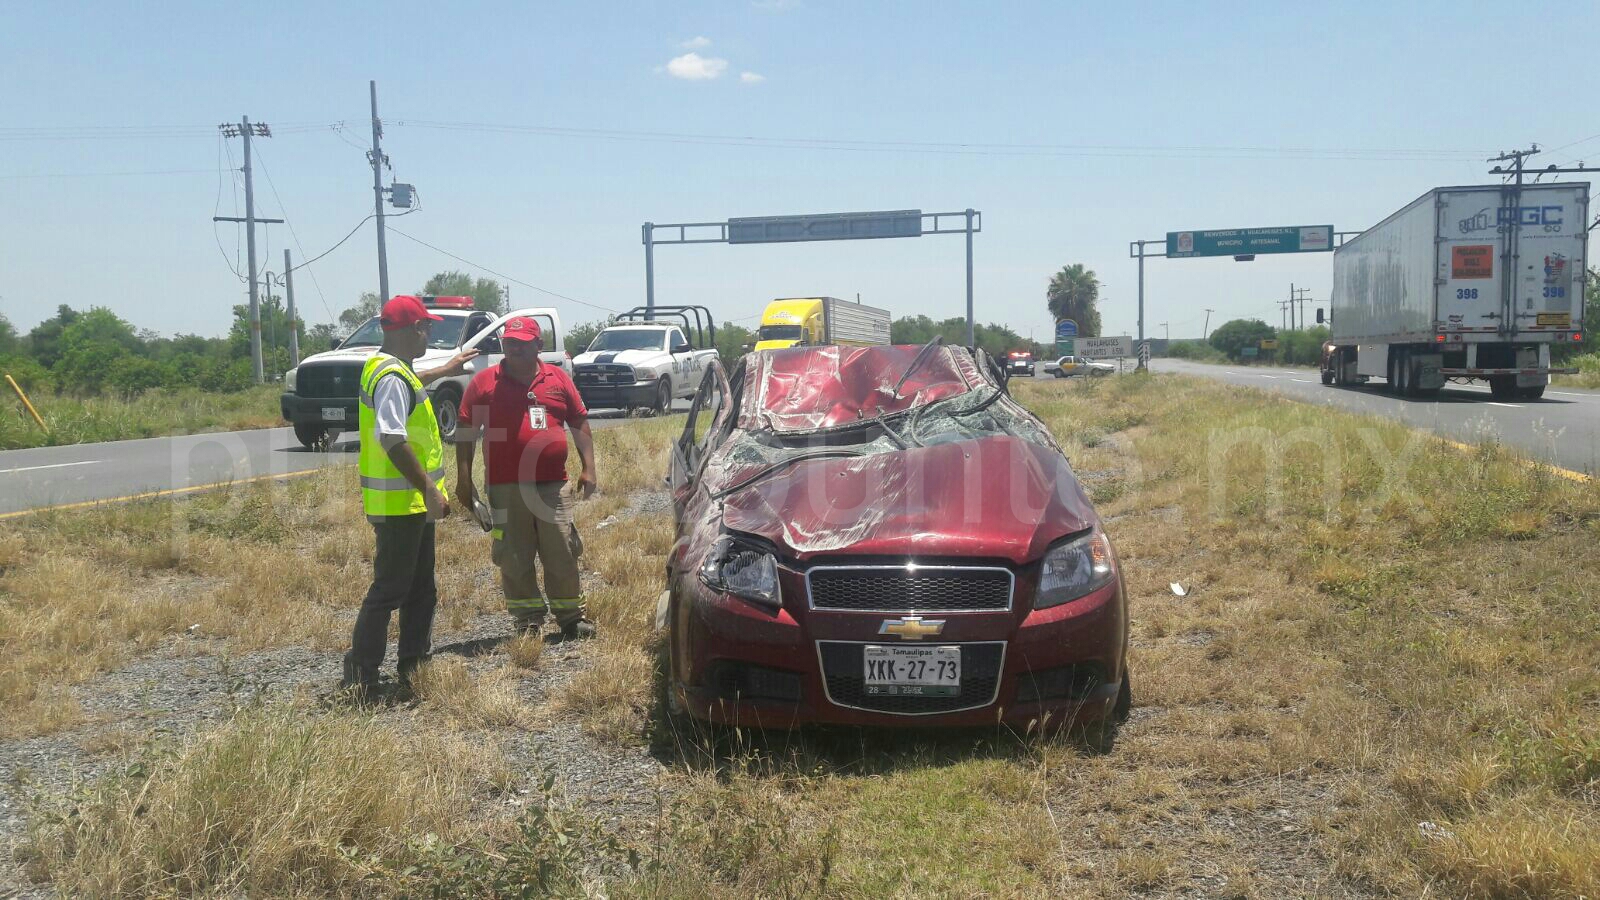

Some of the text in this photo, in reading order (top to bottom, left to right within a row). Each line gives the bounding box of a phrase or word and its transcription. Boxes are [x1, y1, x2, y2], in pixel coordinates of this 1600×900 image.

[1456, 288, 1478, 300] 398
[1542, 286, 1565, 298] 398
[892, 648, 933, 656] Tamaulipas
[868, 660, 957, 680] XKK-27-73
[868, 686, 879, 694] 28
